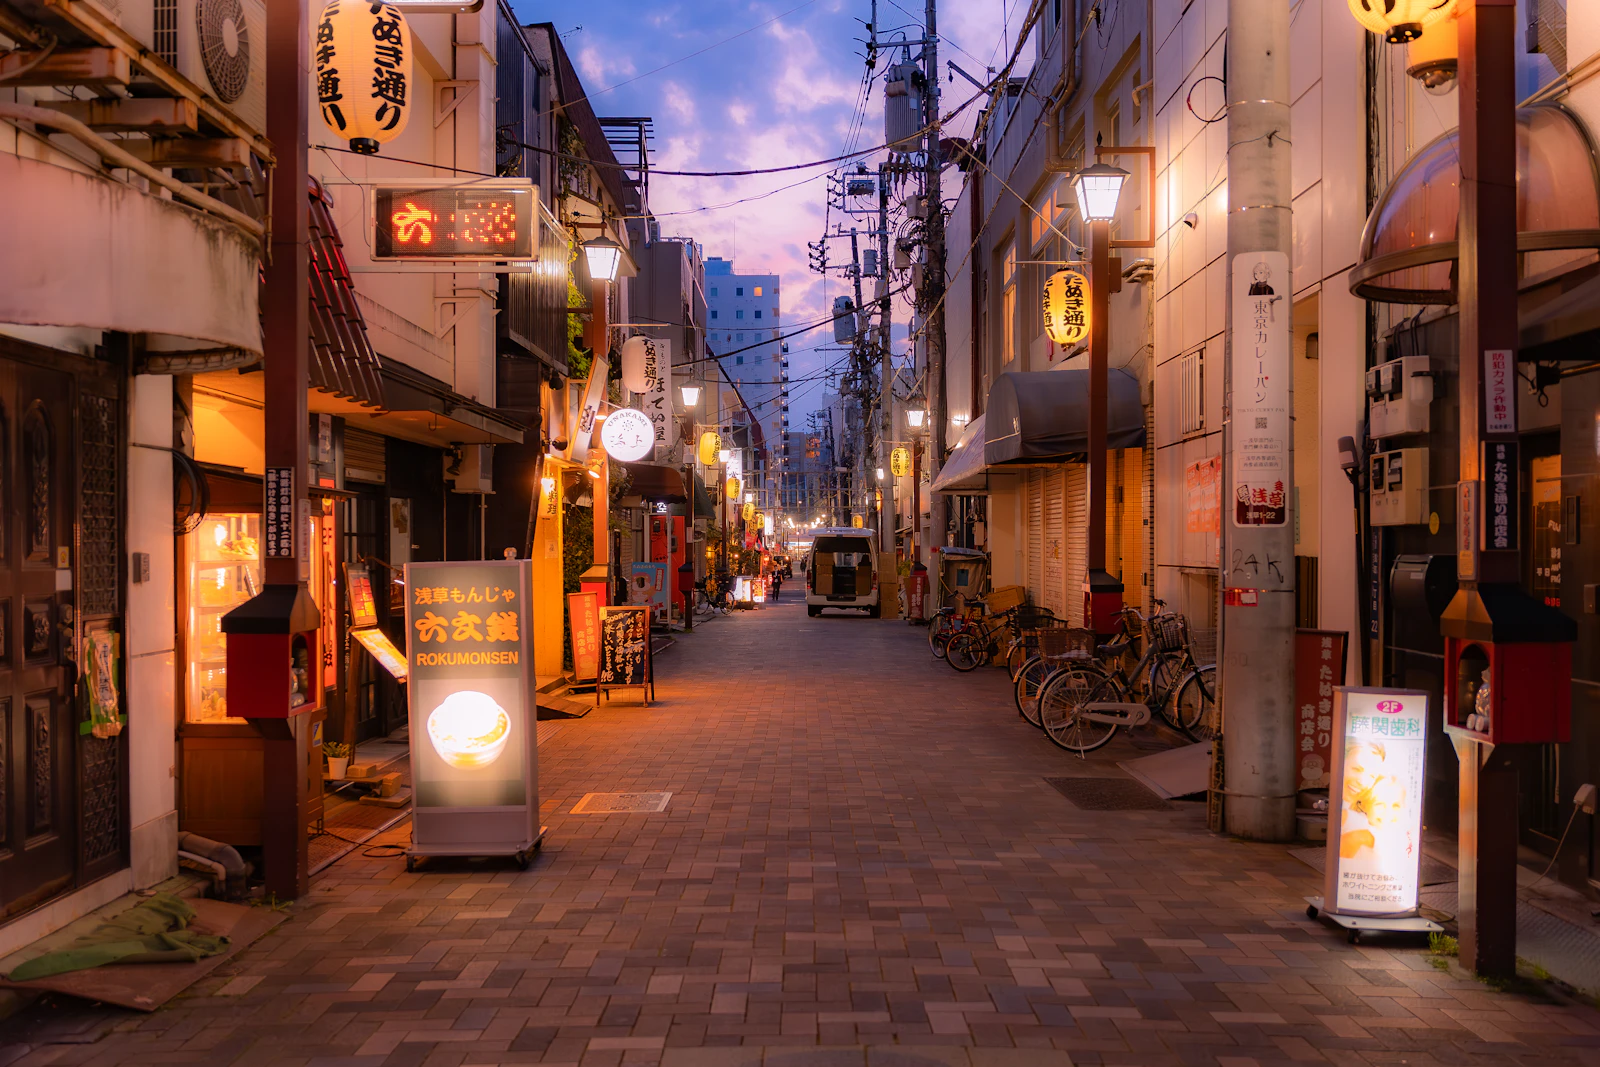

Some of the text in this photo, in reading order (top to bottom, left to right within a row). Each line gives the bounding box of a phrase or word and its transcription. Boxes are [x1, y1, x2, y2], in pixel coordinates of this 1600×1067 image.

[369, 0, 406, 131] たぬき通り
[1063, 274, 1086, 338] たぬき通り
[642, 339, 657, 389] たぬき通り
[1254, 300, 1269, 404] 東京カレーパン
[1492, 352, 1507, 421] 防犯カメラ作動中
[607, 411, 648, 428] UNAKAMI
[1245, 511, 1276, 519] 浅草1-22
[1252, 487, 1284, 507] 浅草
[1494, 461, 1508, 548] たぬき通り商店会
[414, 586, 517, 605] 浅草もんじゃ
[416, 651, 519, 667] ROKUMONSEN
[1317, 636, 1333, 748] 浅草 たぬき通り
[1382, 701, 1399, 713] 2F
[1300, 703, 1316, 752] 商店会
[1351, 715, 1421, 737] 藤関歯科
